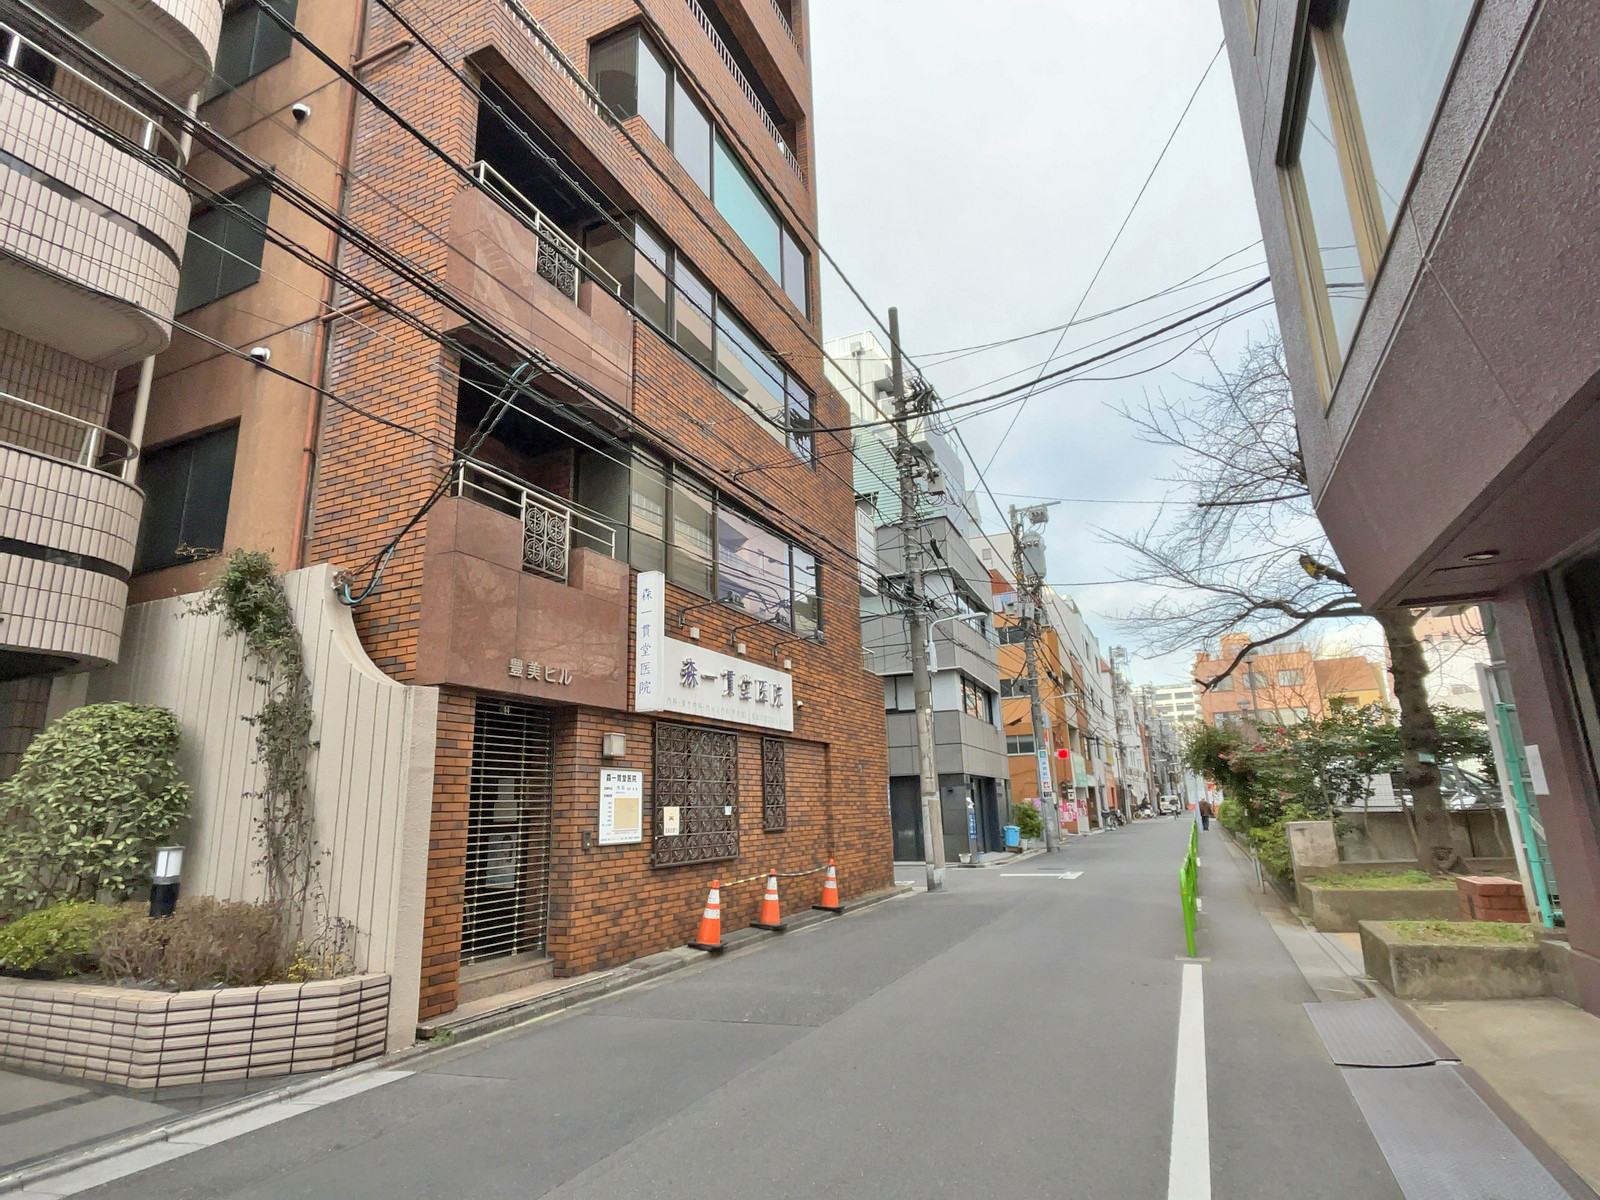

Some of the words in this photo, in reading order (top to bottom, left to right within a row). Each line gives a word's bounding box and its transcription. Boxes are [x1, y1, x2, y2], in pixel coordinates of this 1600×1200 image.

[639, 587, 653, 695] 森一貫堂医院
[680, 658, 784, 708] 森一貫堂医院
